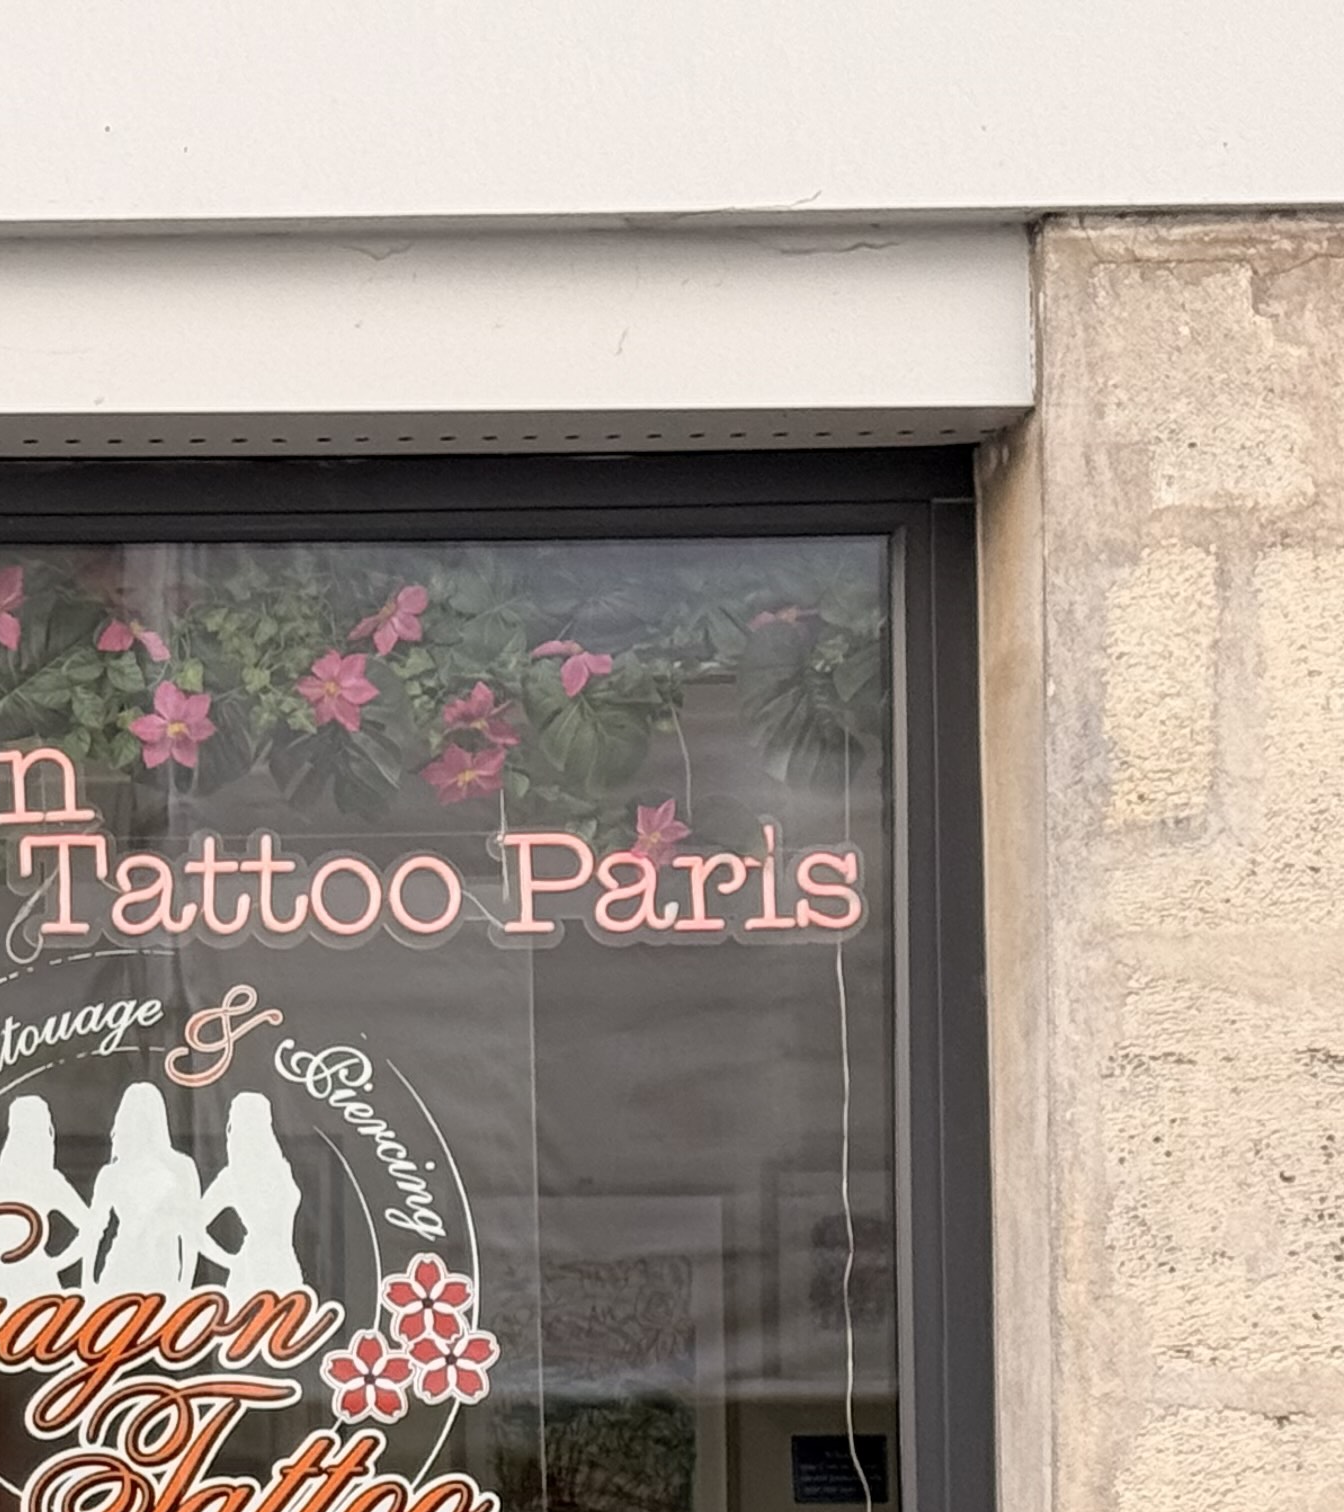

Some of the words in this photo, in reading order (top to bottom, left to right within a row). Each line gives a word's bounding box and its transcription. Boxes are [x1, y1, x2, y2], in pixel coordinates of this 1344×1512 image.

[19, 833, 461, 936] Tattoo
[503, 825, 863, 934] Paris
[164, 984, 284, 1087] &
[274, 1039, 448, 1243] Piercing
